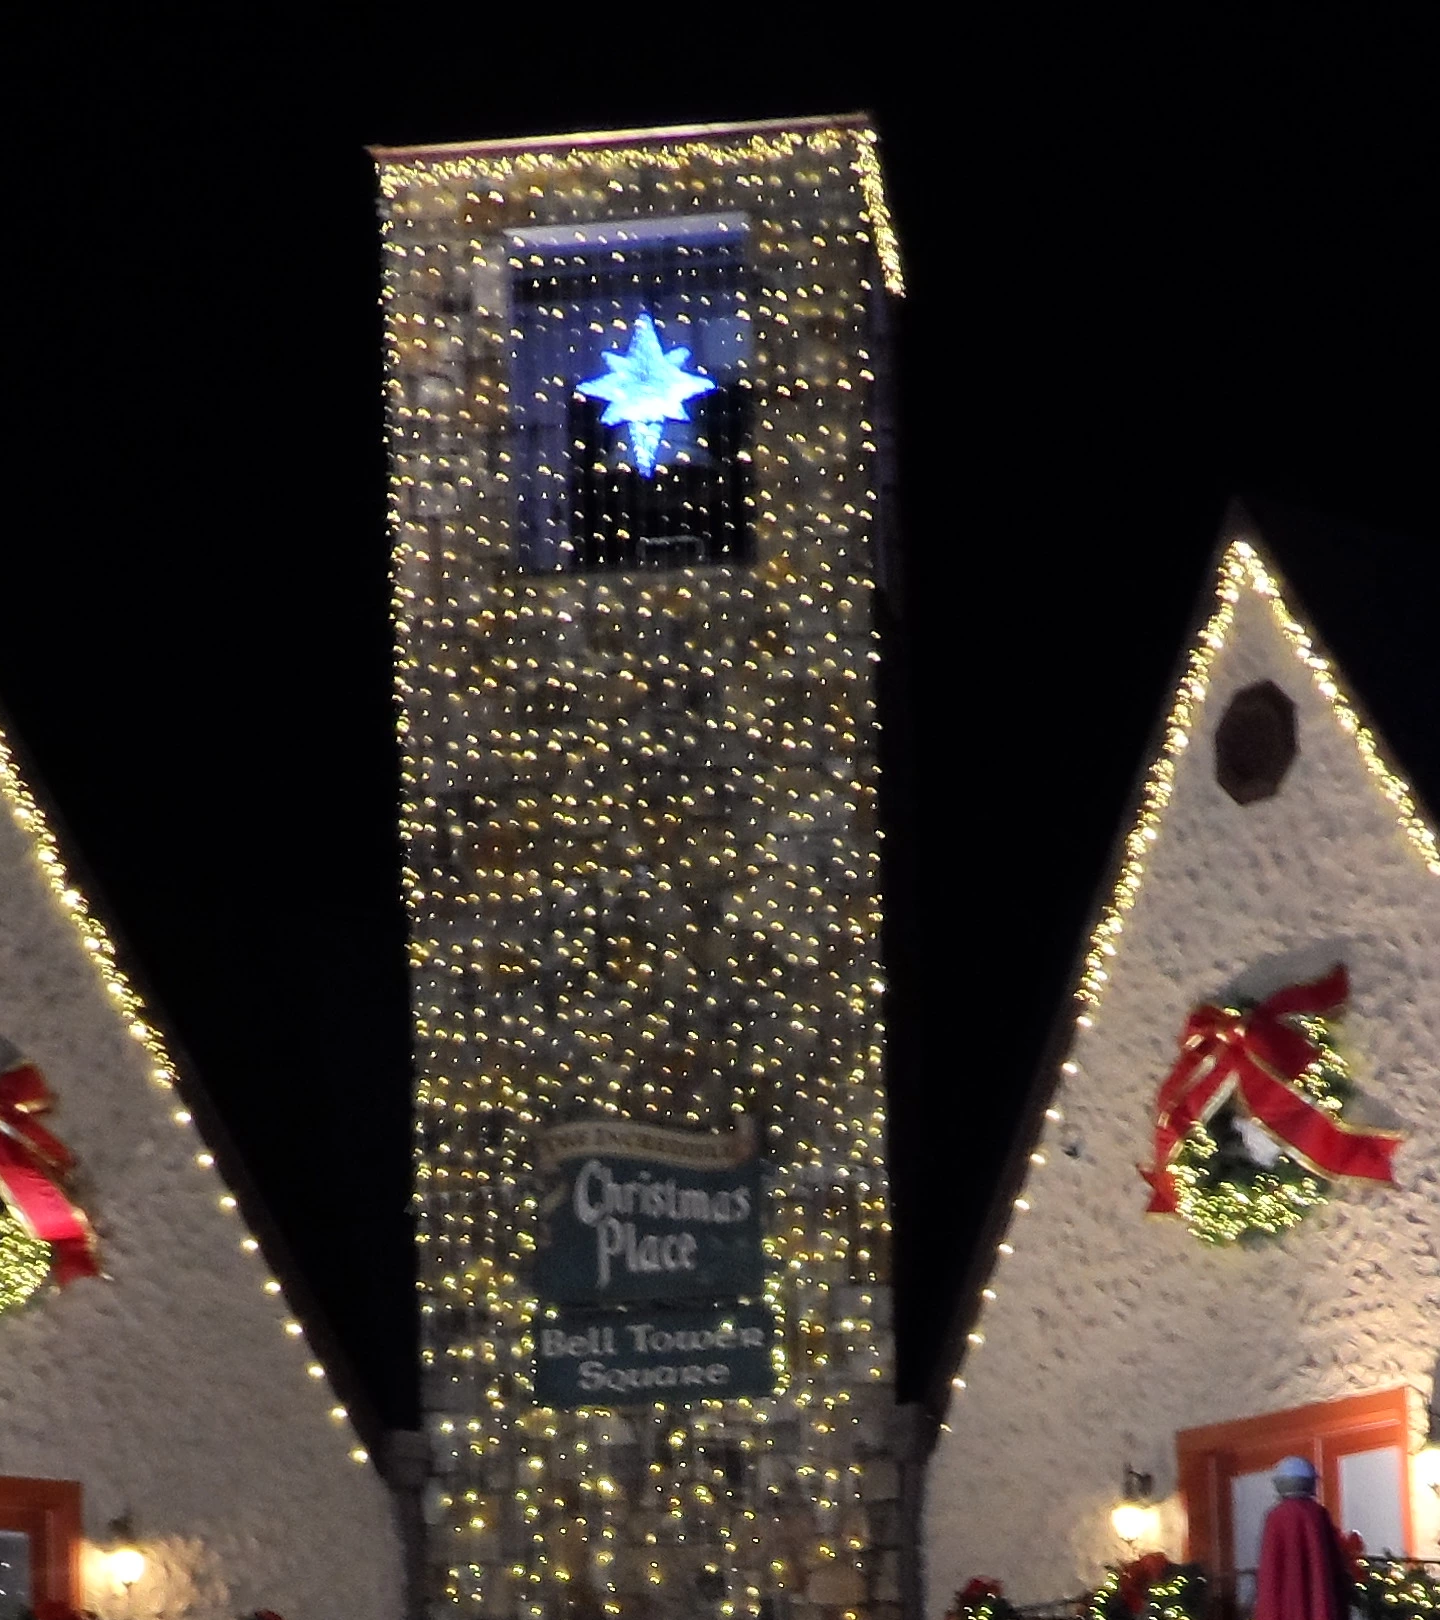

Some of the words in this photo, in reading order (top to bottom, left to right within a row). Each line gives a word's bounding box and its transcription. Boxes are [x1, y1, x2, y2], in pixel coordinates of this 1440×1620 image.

[573, 1159, 751, 1227] Christmas
[596, 1217, 698, 1289] Place
[540, 1327, 616, 1357] Bell
[577, 1359, 730, 1393] Square
